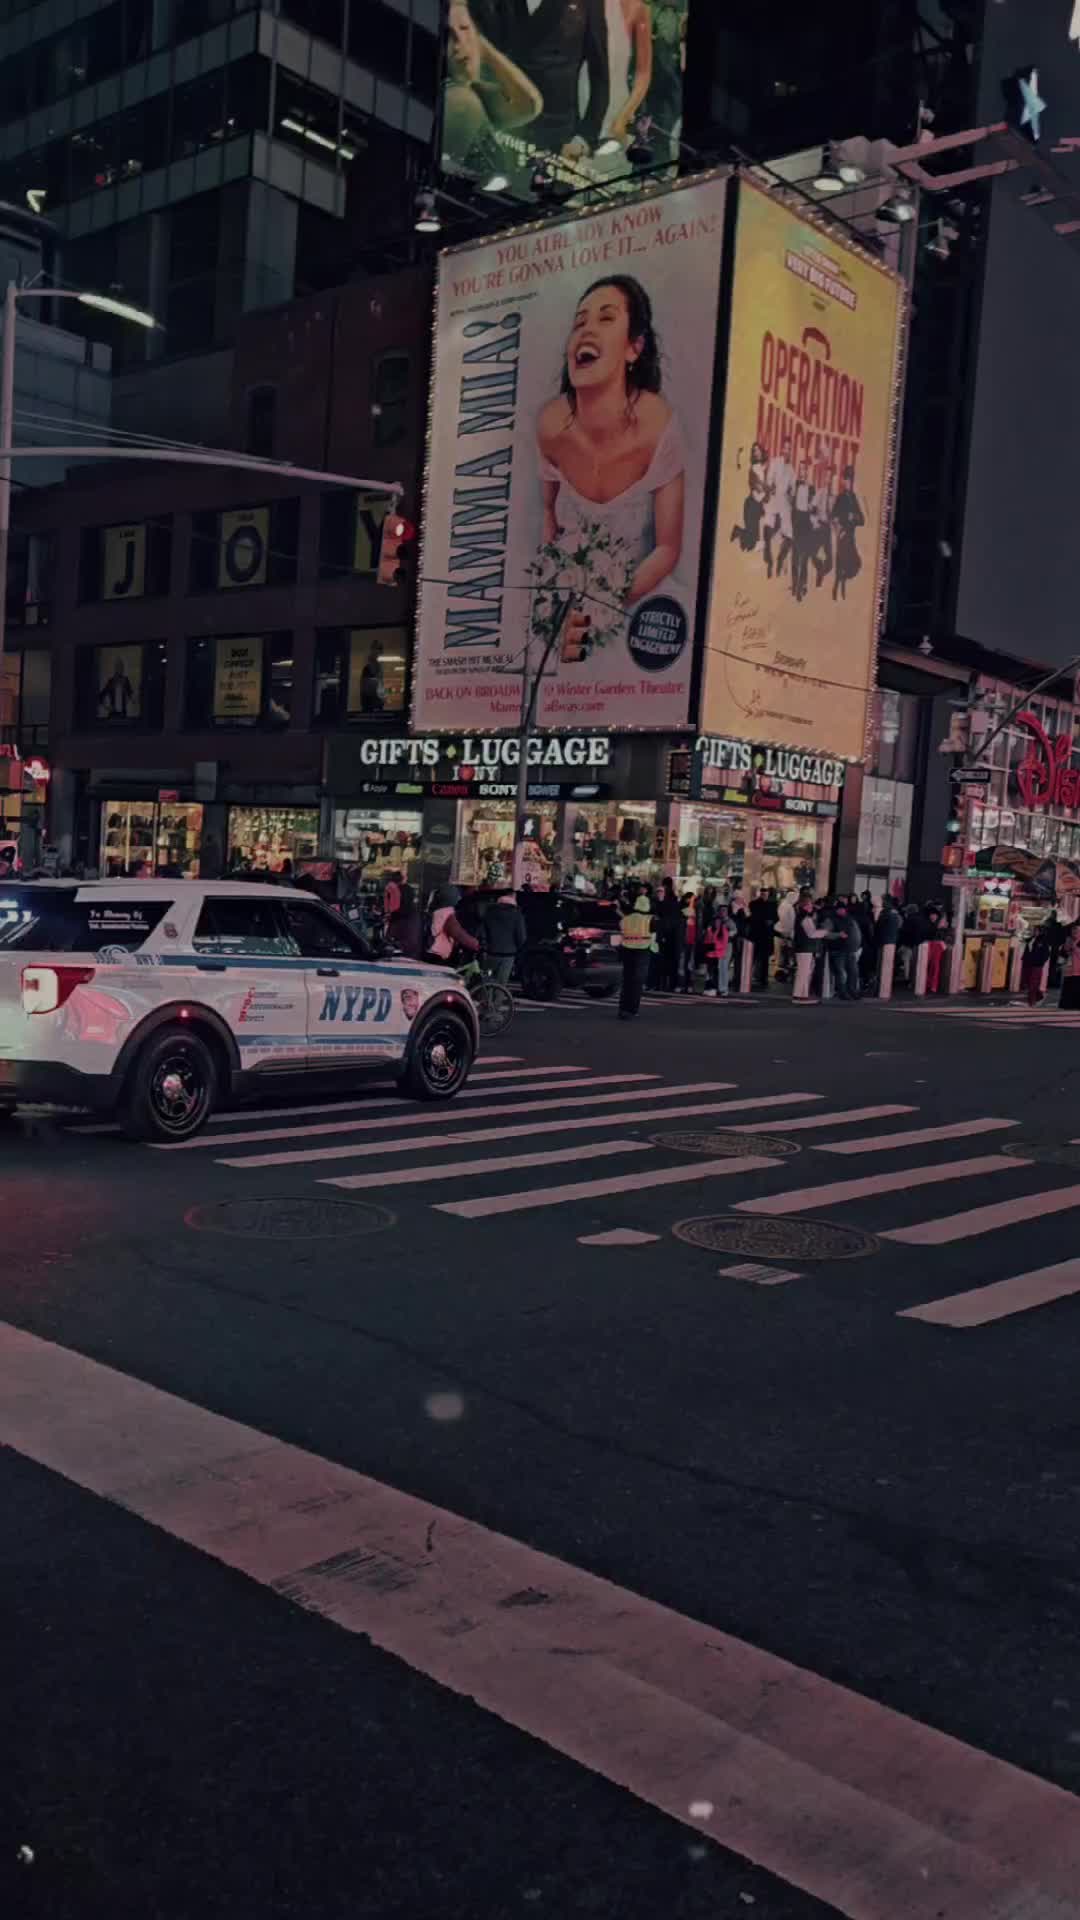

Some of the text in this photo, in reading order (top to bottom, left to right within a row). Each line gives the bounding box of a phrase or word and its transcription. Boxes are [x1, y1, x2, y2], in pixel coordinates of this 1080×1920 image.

[496, 239, 528, 265] YOU
[611, 206, 663, 235] KNOW
[453, 271, 505, 297] YOU'RE
[509, 256, 564, 283] GONNA
[571, 241, 613, 268] LOVE
[760, 330, 865, 438] OPERATION
[444, 446, 514, 650] MAMMA
[639, 609, 682, 629] STRICTLY
[425, 686, 452, 701] BACK
[454, 686, 472, 698] ON
[475, 682, 521, 698] BROADW
[556, 681, 593, 696] Winter
[360, 737, 609, 766] GIFTS LUGGAGE
[695, 736, 845, 787] GIFTS LUGGAGE
[479, 783, 518, 796] SONY
[319, 984, 393, 1022] NYPD
